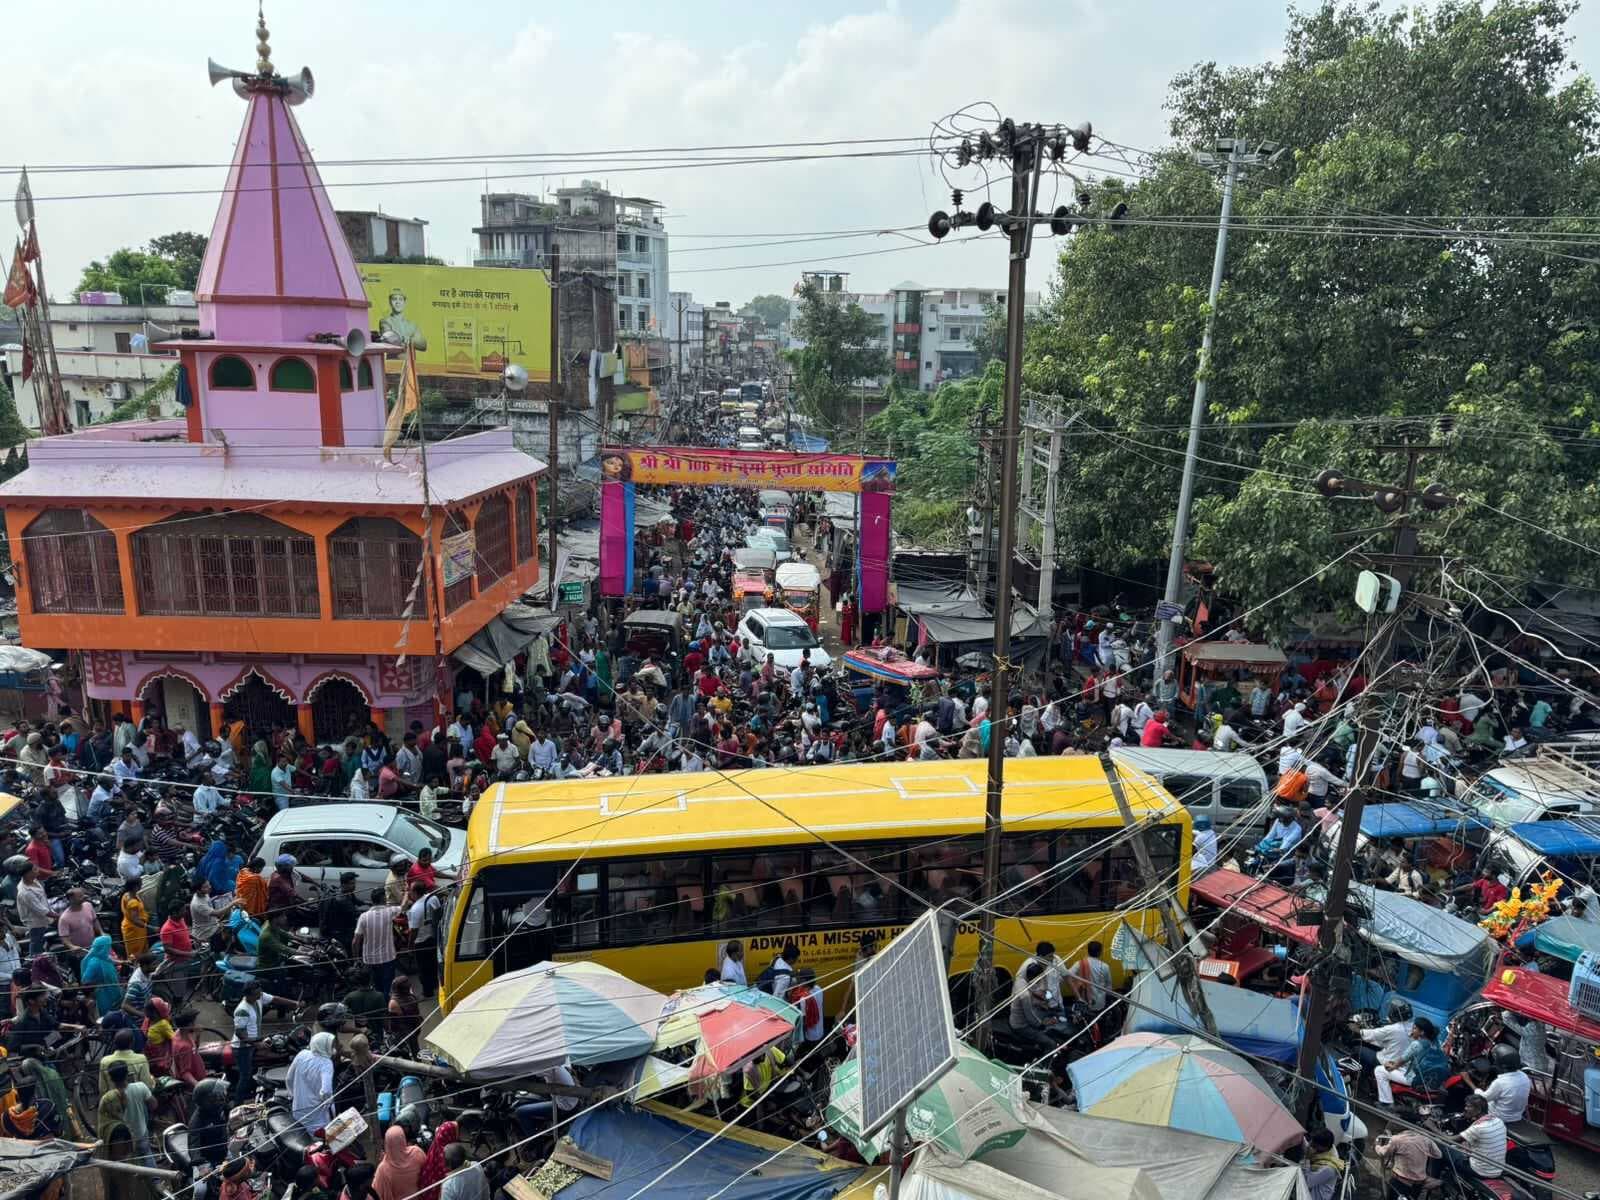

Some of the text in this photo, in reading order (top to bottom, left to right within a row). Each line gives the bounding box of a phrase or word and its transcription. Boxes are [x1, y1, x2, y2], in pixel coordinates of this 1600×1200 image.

[640, 454, 658, 470] श्री
[663, 457, 680, 471] श्री
[771, 463, 802, 480] पूजा
[807, 462, 856, 476] समिति
[750, 934, 818, 951] ADWAITA
